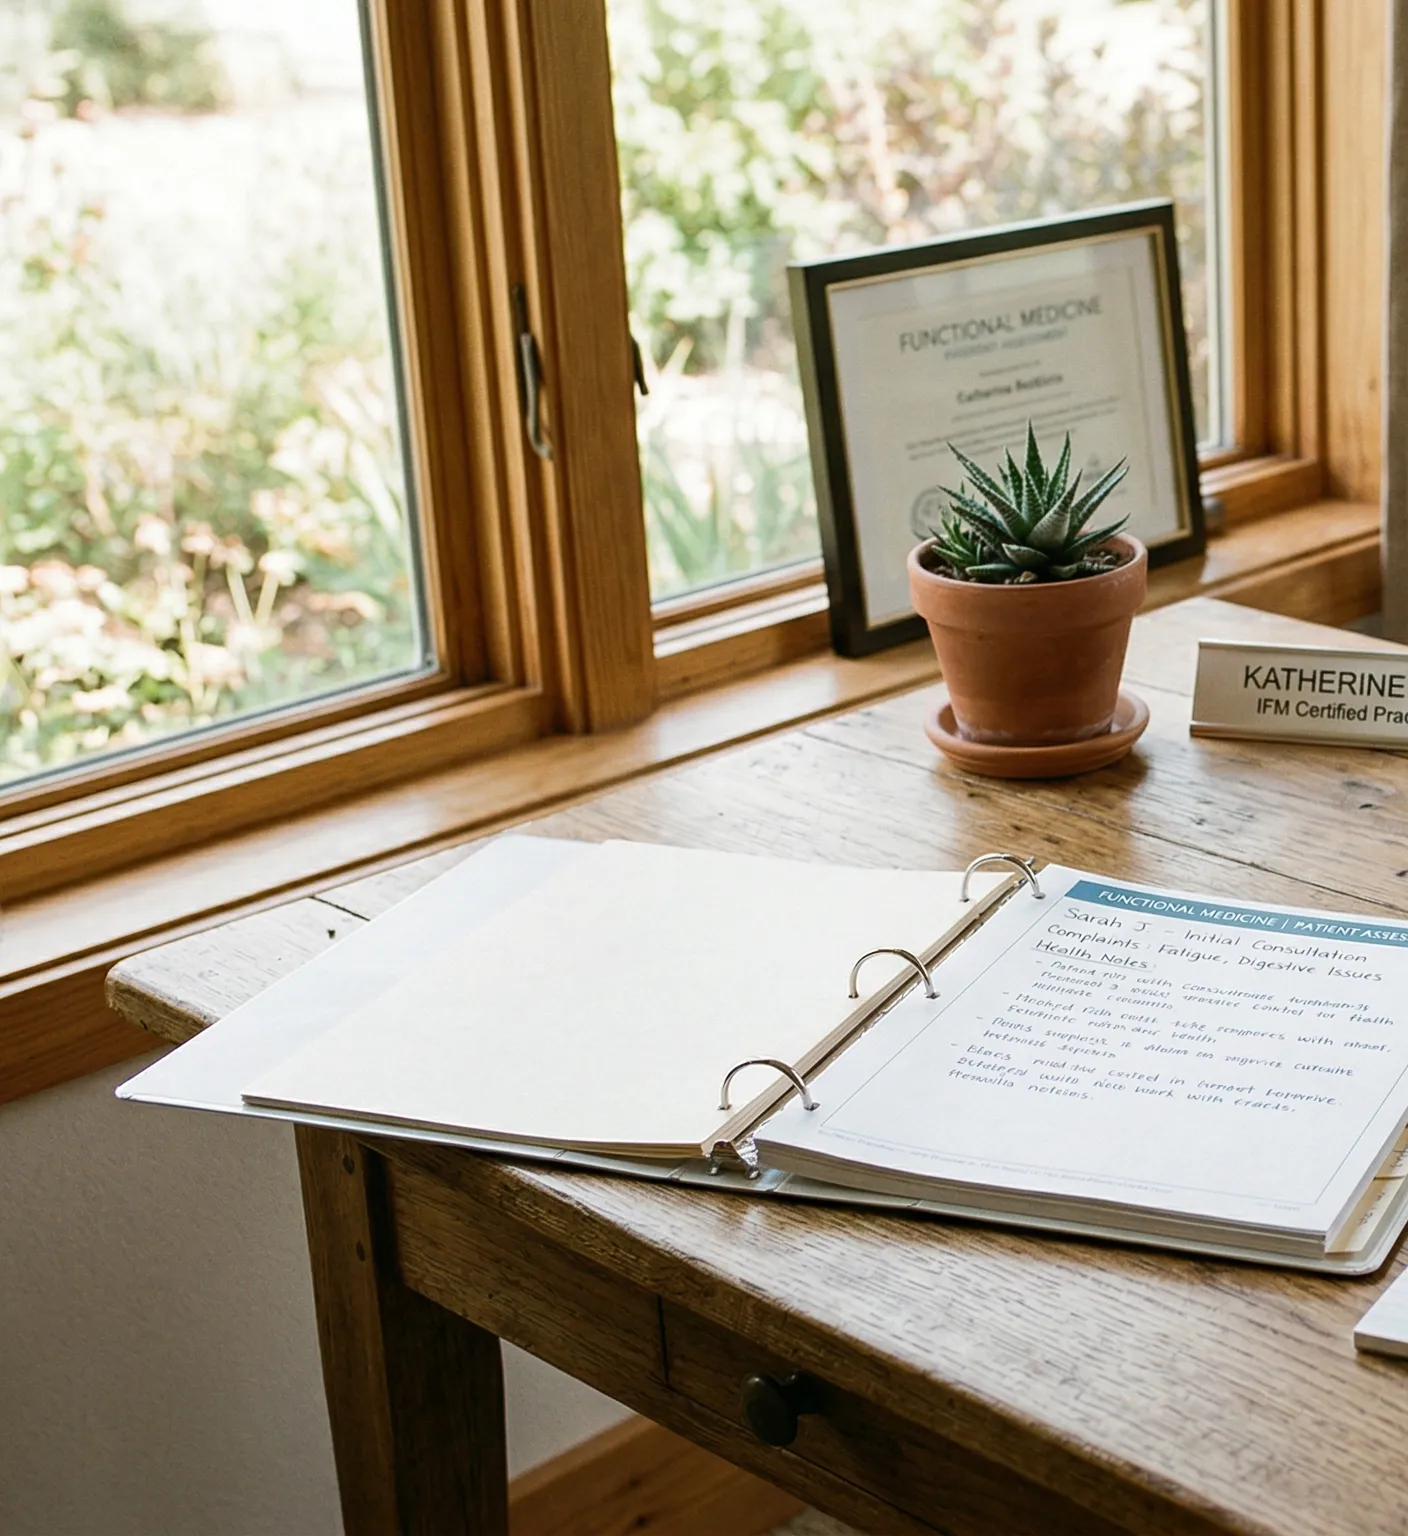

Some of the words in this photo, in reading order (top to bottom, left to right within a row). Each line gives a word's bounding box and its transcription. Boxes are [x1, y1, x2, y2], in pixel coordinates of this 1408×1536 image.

[898, 313, 1019, 354] FUNCTIONAL
[1020, 294, 1104, 327] MEDICINE
[1244, 665, 1406, 699] KATHERINE
[1256, 698, 1290, 716] IFM
[1295, 700, 1368, 723] Certified
[1098, 889, 1195, 916] FUNCTIONAL
[1199, 906, 1276, 927] MEDICINE
[1293, 921, 1361, 937] PATIENT
[1035, 939, 1092, 960] Health
[1063, 907, 1123, 929] Sarah
[1184, 929, 1241, 946] Initial
[1251, 938, 1367, 963] Consultation
[1158, 944, 1229, 965] Fatigue,
[1238, 954, 1316, 975] Digestive
[1328, 966, 1383, 982] Issues
